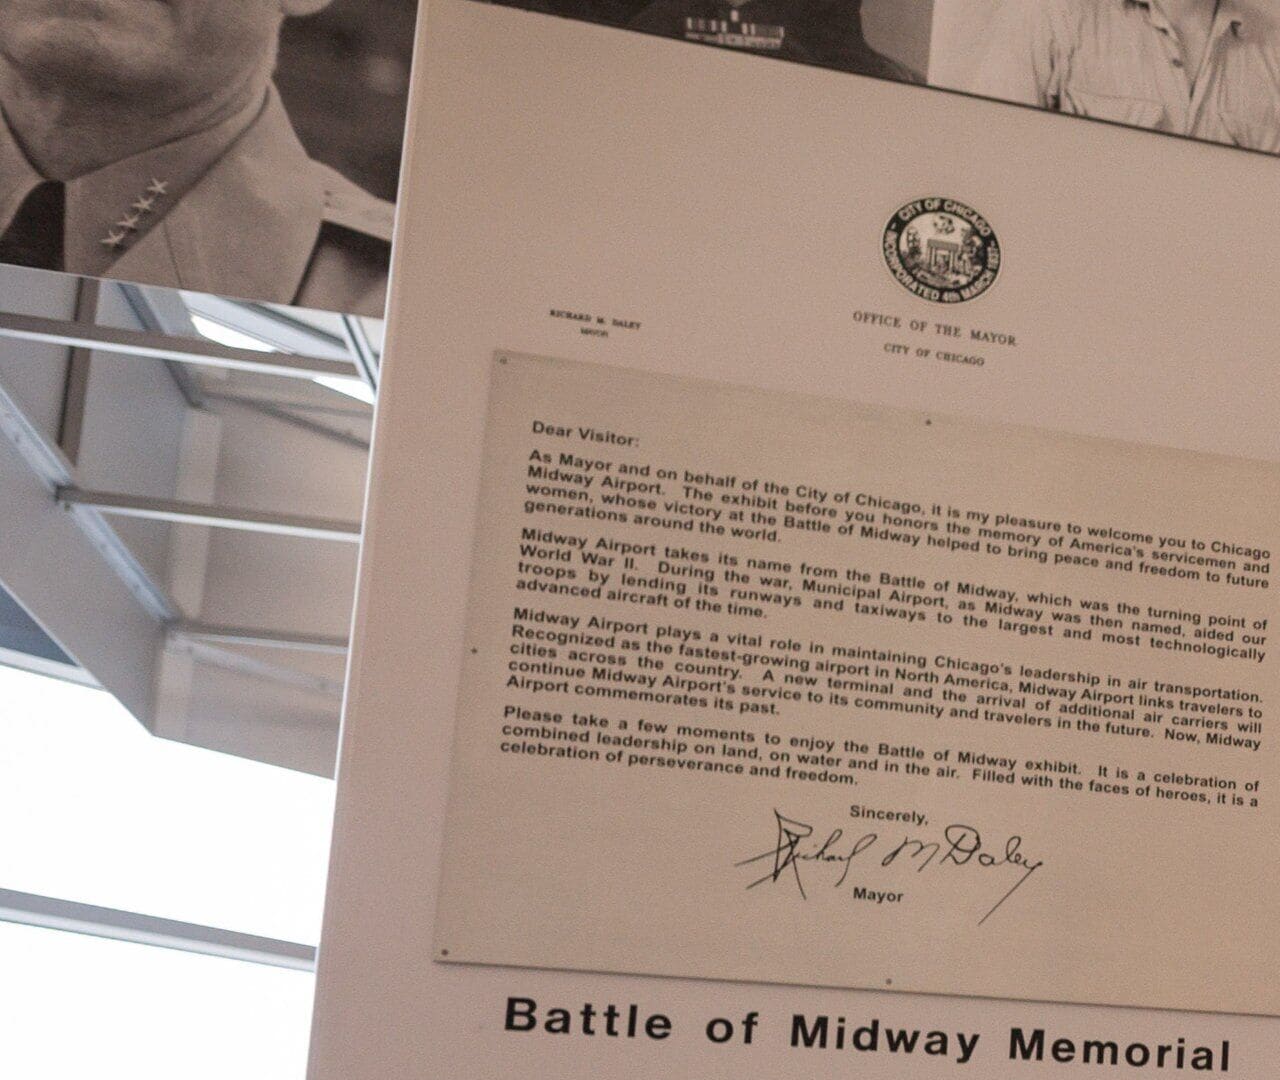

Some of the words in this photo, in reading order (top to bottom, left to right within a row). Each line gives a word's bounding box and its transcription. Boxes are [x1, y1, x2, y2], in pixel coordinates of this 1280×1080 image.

[899, 199, 922, 221] CITY
[924, 198, 941, 212] OF
[943, 199, 992, 238] CHICAGO
[853, 310, 902, 328] OFFICE
[910, 320, 928, 333] OF
[934, 323, 962, 338] THE
[970, 329, 1018, 347] MAYOR
[884, 342, 910, 355] CITY
[916, 347, 931, 358] OF
[936, 350, 986, 367] CHICAGO
[531, 419, 572, 438] Dear
[577, 426, 640, 446] Visitor:
[523, 499, 628, 523] generations
[632, 514, 694, 531] around
[698, 520, 725, 535] the
[730, 527, 783, 542] world.
[526, 463, 594, 488] Midway
[600, 474, 666, 495] Airport.
[682, 484, 713, 501] The
[720, 493, 778, 510] exhibit
[784, 499, 838, 518] before
[844, 510, 875, 523] you
[881, 512, 938, 531] honors
[945, 521, 971, 535] the
[977, 527, 1041, 547] memory
[1047, 535, 1064, 547] of
[1068, 536, 1144, 558] America's
[1150, 549, 1236, 569] servicemen
[1242, 561, 1270, 574] and
[528, 448, 552, 464] As
[558, 451, 612, 472] Mayor
[617, 463, 650, 477] and
[655, 468, 678, 480] on
[683, 469, 736, 488] behalf
[740, 478, 758, 491] of
[763, 481, 790, 496] the
[794, 484, 828, 503] City
[832, 491, 850, 503] of
[854, 492, 925, 515] Chicago,
[930, 503, 942, 516] it
[946, 505, 960, 519] is
[965, 510, 990, 525] my
[994, 513, 1062, 532] pleasure
[1066, 522, 1082, 535] to
[1086, 526, 1153, 544] welcome
[1158, 536, 1186, 549] you
[1190, 538, 1206, 551] to
[1210, 539, 1271, 561] Chicago
[525, 483, 593, 503] women,
[600, 492, 657, 510] whose
[663, 501, 722, 521] victory
[728, 509, 744, 522] at
[750, 511, 777, 526] the
[782, 514, 831, 533] Battle
[836, 522, 854, 536] of
[859, 524, 920, 547] Midway
[926, 533, 980, 552] helped
[985, 542, 1002, 555] to
[1006, 544, 1048, 564] bring
[1053, 552, 1099, 567] peace
[1104, 559, 1133, 572] and
[1138, 560, 1200, 580] freedom
[1205, 570, 1220, 583] to
[1225, 571, 1269, 589] future
[850, 804, 929, 826] Sincerely,
[852, 886, 904, 904] Mayor
[504, 996, 672, 1040] Battle
[705, 1010, 758, 1044] of
[790, 1013, 980, 1064] Midway
[1008, 1026, 1229, 1072] Memorial
